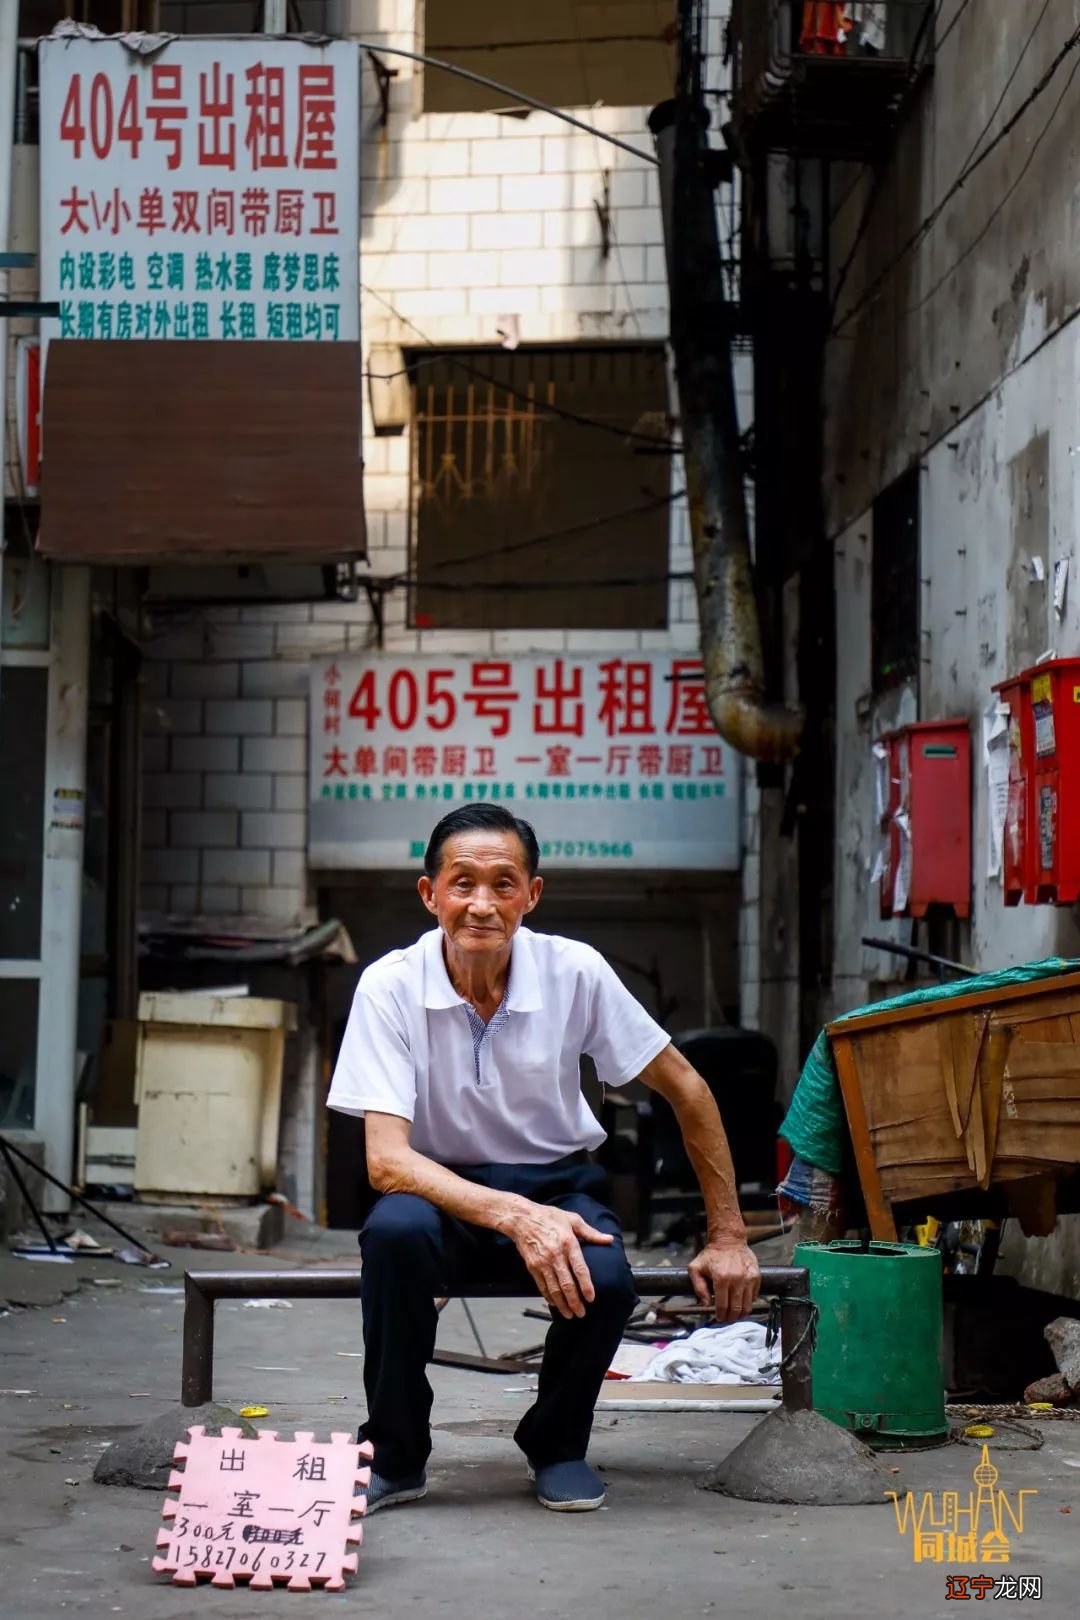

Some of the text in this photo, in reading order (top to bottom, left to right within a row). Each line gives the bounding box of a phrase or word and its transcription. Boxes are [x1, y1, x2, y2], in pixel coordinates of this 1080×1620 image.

[60, 61, 338, 171] 404号出租屋
[59, 251, 340, 292] 内设彩电 空调 热水器 席梦思床
[59, 299, 340, 341] 长期有房对外出租 长租 短租均可
[348, 658, 719, 738] 405号出租屋
[323, 745, 725, 777] 大单间带厨卫 一室一厅带厨卫
[177, 1517, 234, 1541] 300元
[176, 1545, 326, 1573] 15827060327
